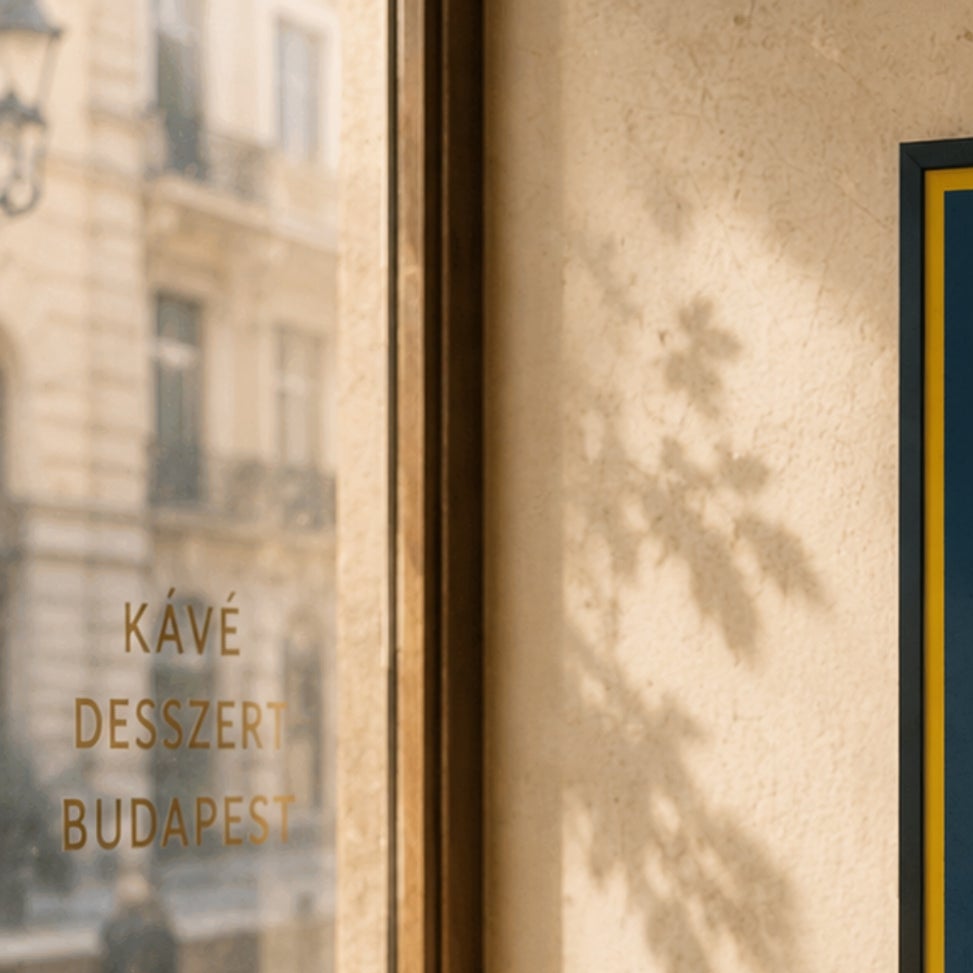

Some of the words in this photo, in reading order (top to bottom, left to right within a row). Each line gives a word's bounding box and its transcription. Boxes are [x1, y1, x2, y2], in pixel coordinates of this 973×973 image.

[124, 587, 240, 656] KÁVÉ
[75, 697, 288, 750] DESSZERT
[62, 795, 295, 851] BUDAPEST
